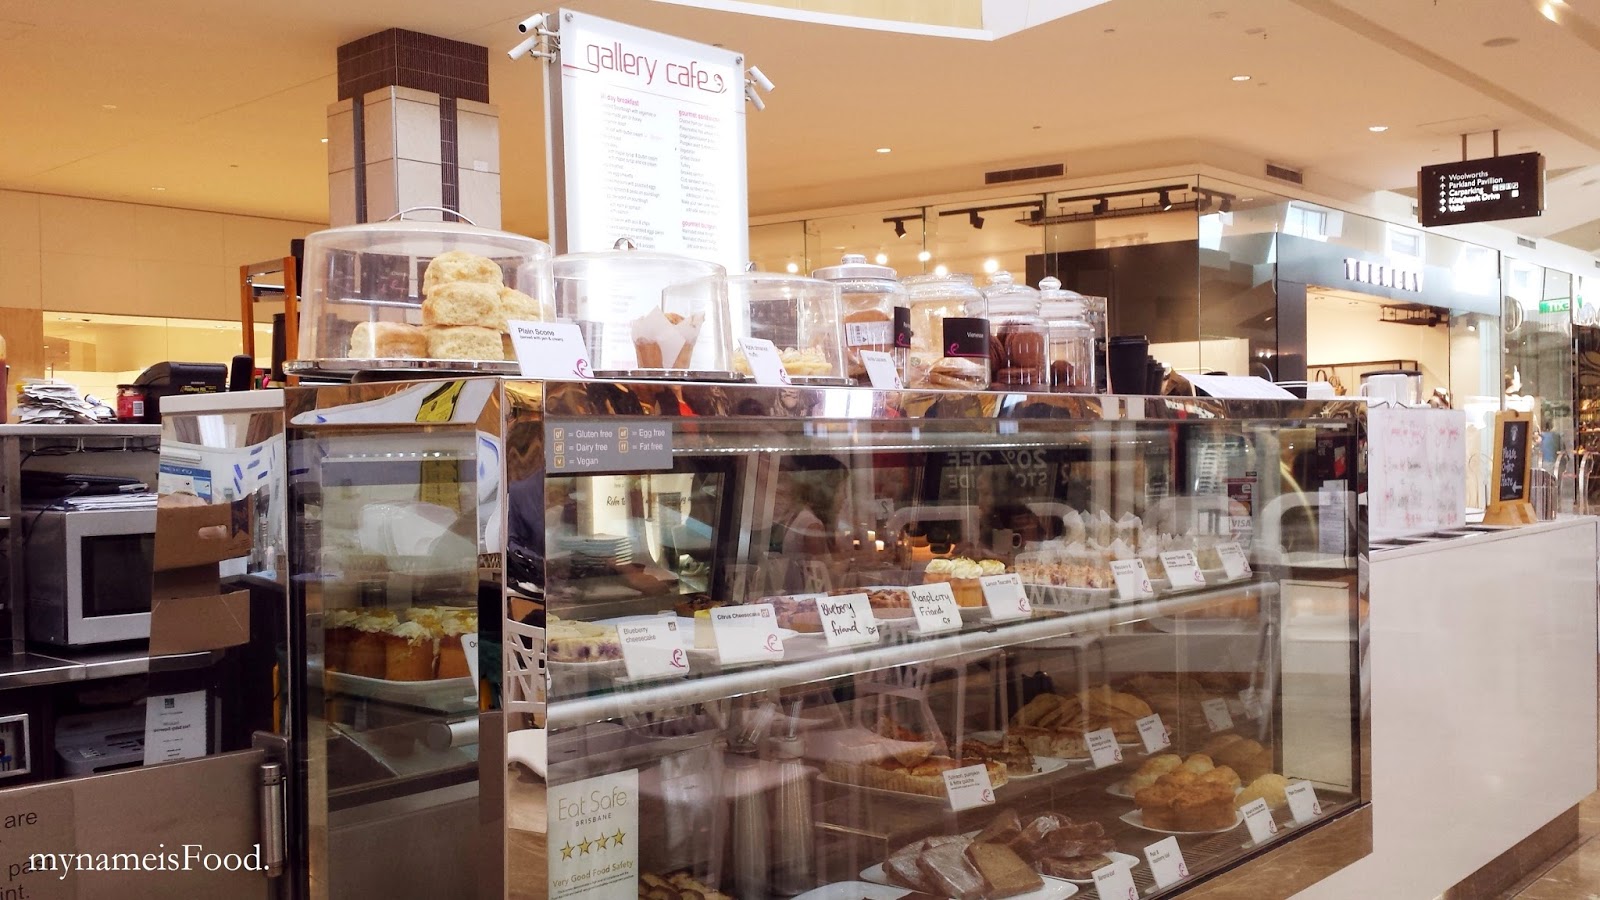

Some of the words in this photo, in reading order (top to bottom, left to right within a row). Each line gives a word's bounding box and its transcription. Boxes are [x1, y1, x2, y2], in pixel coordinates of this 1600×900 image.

[586, 42, 658, 85] gallery
[665, 61, 709, 92] cafe
[1449, 170, 1489, 181] Woolworths
[1449, 179, 1476, 189] Parkland
[1449, 187, 1484, 198] Carparking
[1481, 193, 1501, 202] Drive
[518, 327, 534, 335] Plain
[535, 328, 555, 337] Scone
[576, 429, 599, 439] Gluten
[600, 429, 613, 438] free
[639, 428, 652, 439] Egg
[653, 428, 666, 437] free
[576, 443, 594, 454] Dairy
[595, 443, 608, 452] free
[639, 442, 650, 451] Fat
[650, 442, 664, 451] free
[576, 456, 599, 467] Vegan
[1231, 518, 1251, 528] VISA
[623, 627, 648, 635] Blueberry
[625, 634, 657, 643] cheesecake
[558, 797, 586, 821] Eat
[591, 786, 628, 813] Safe
[4, 812, 38, 829] are
[575, 812, 612, 827] BRISBANE
[553, 878, 569, 888] Very
[571, 870, 591, 883] Good
[592, 864, 611, 878] Food
[612, 860, 634, 872] Safety
